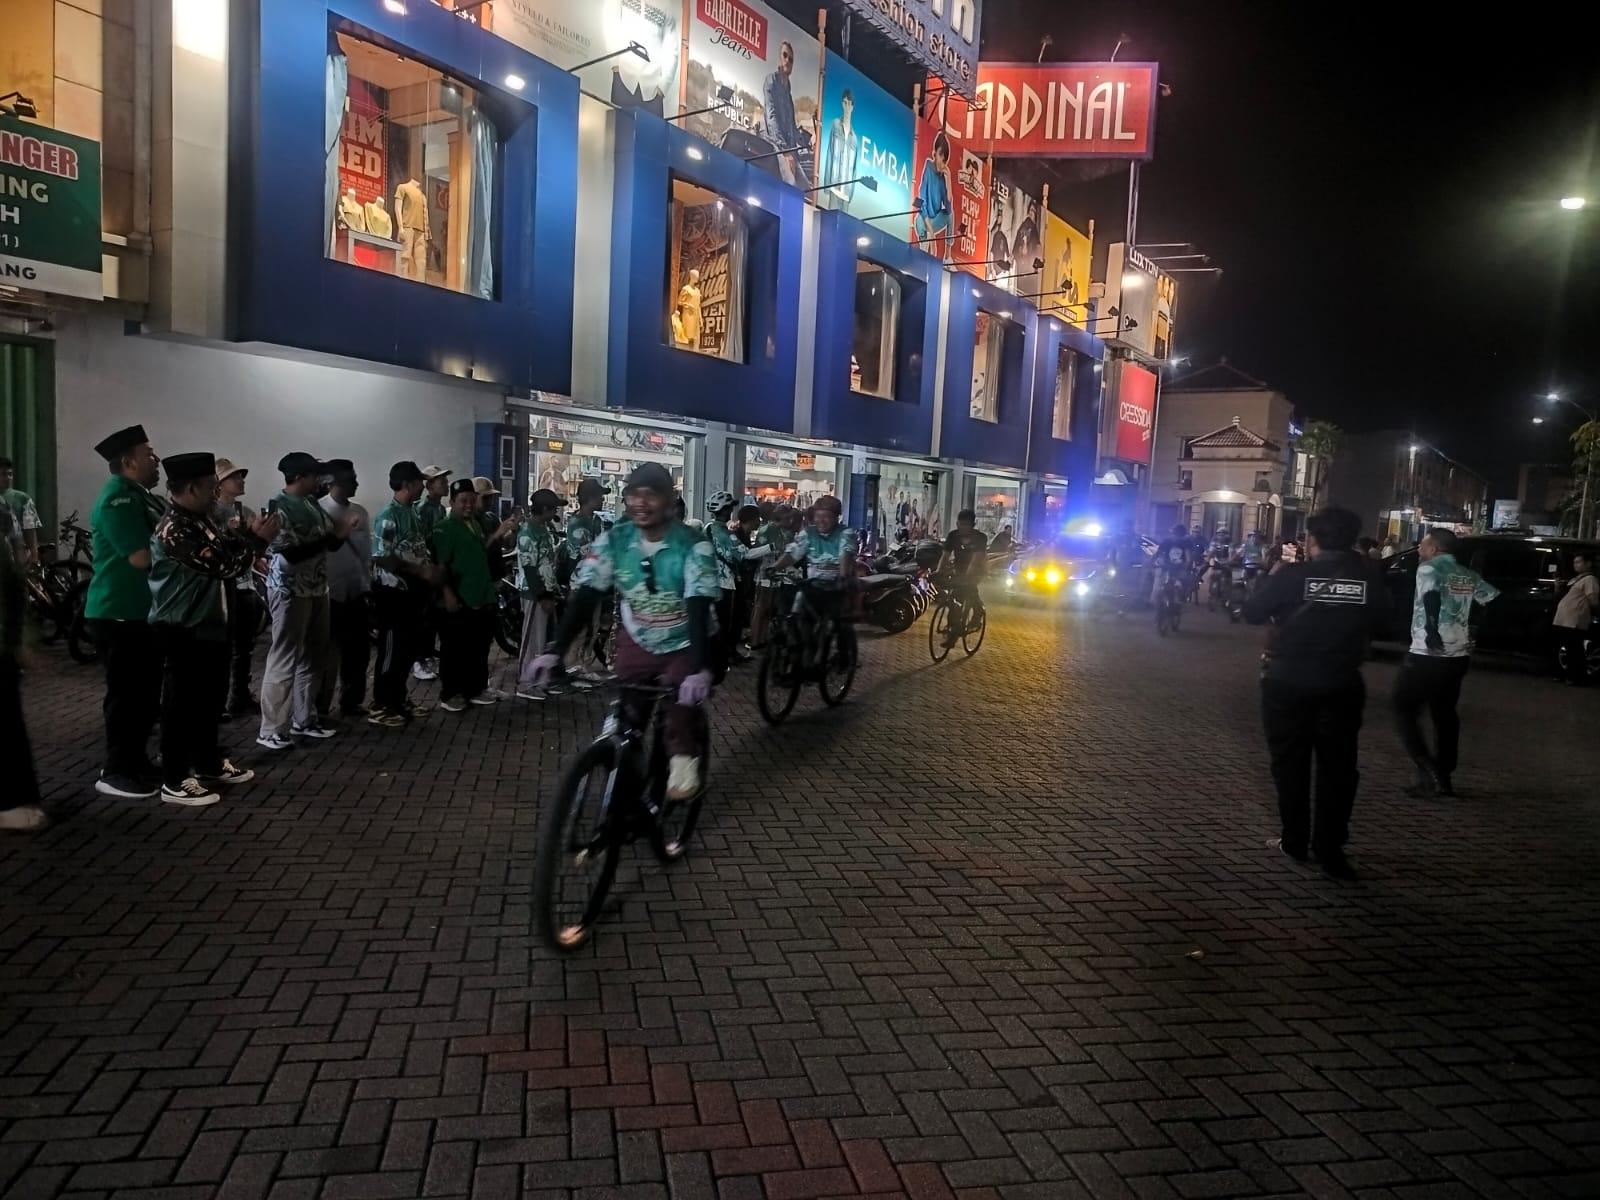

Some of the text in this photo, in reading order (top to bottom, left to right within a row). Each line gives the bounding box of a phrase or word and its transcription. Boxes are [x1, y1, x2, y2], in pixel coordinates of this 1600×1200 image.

[704, 0, 762, 50] GABRIELLE
[709, 26, 753, 61] Jeans
[929, 32, 970, 82] store
[707, 96, 750, 129] REPUBLIC
[938, 81, 1137, 140] CARDINAL
[0, 130, 79, 181] NGER
[860, 135, 910, 191] EMBA
[961, 194, 981, 219] PLAY
[960, 236, 976, 257] DAY
[1129, 246, 1159, 279] LUXTON
[1120, 401, 1152, 430] CRESSIDA
